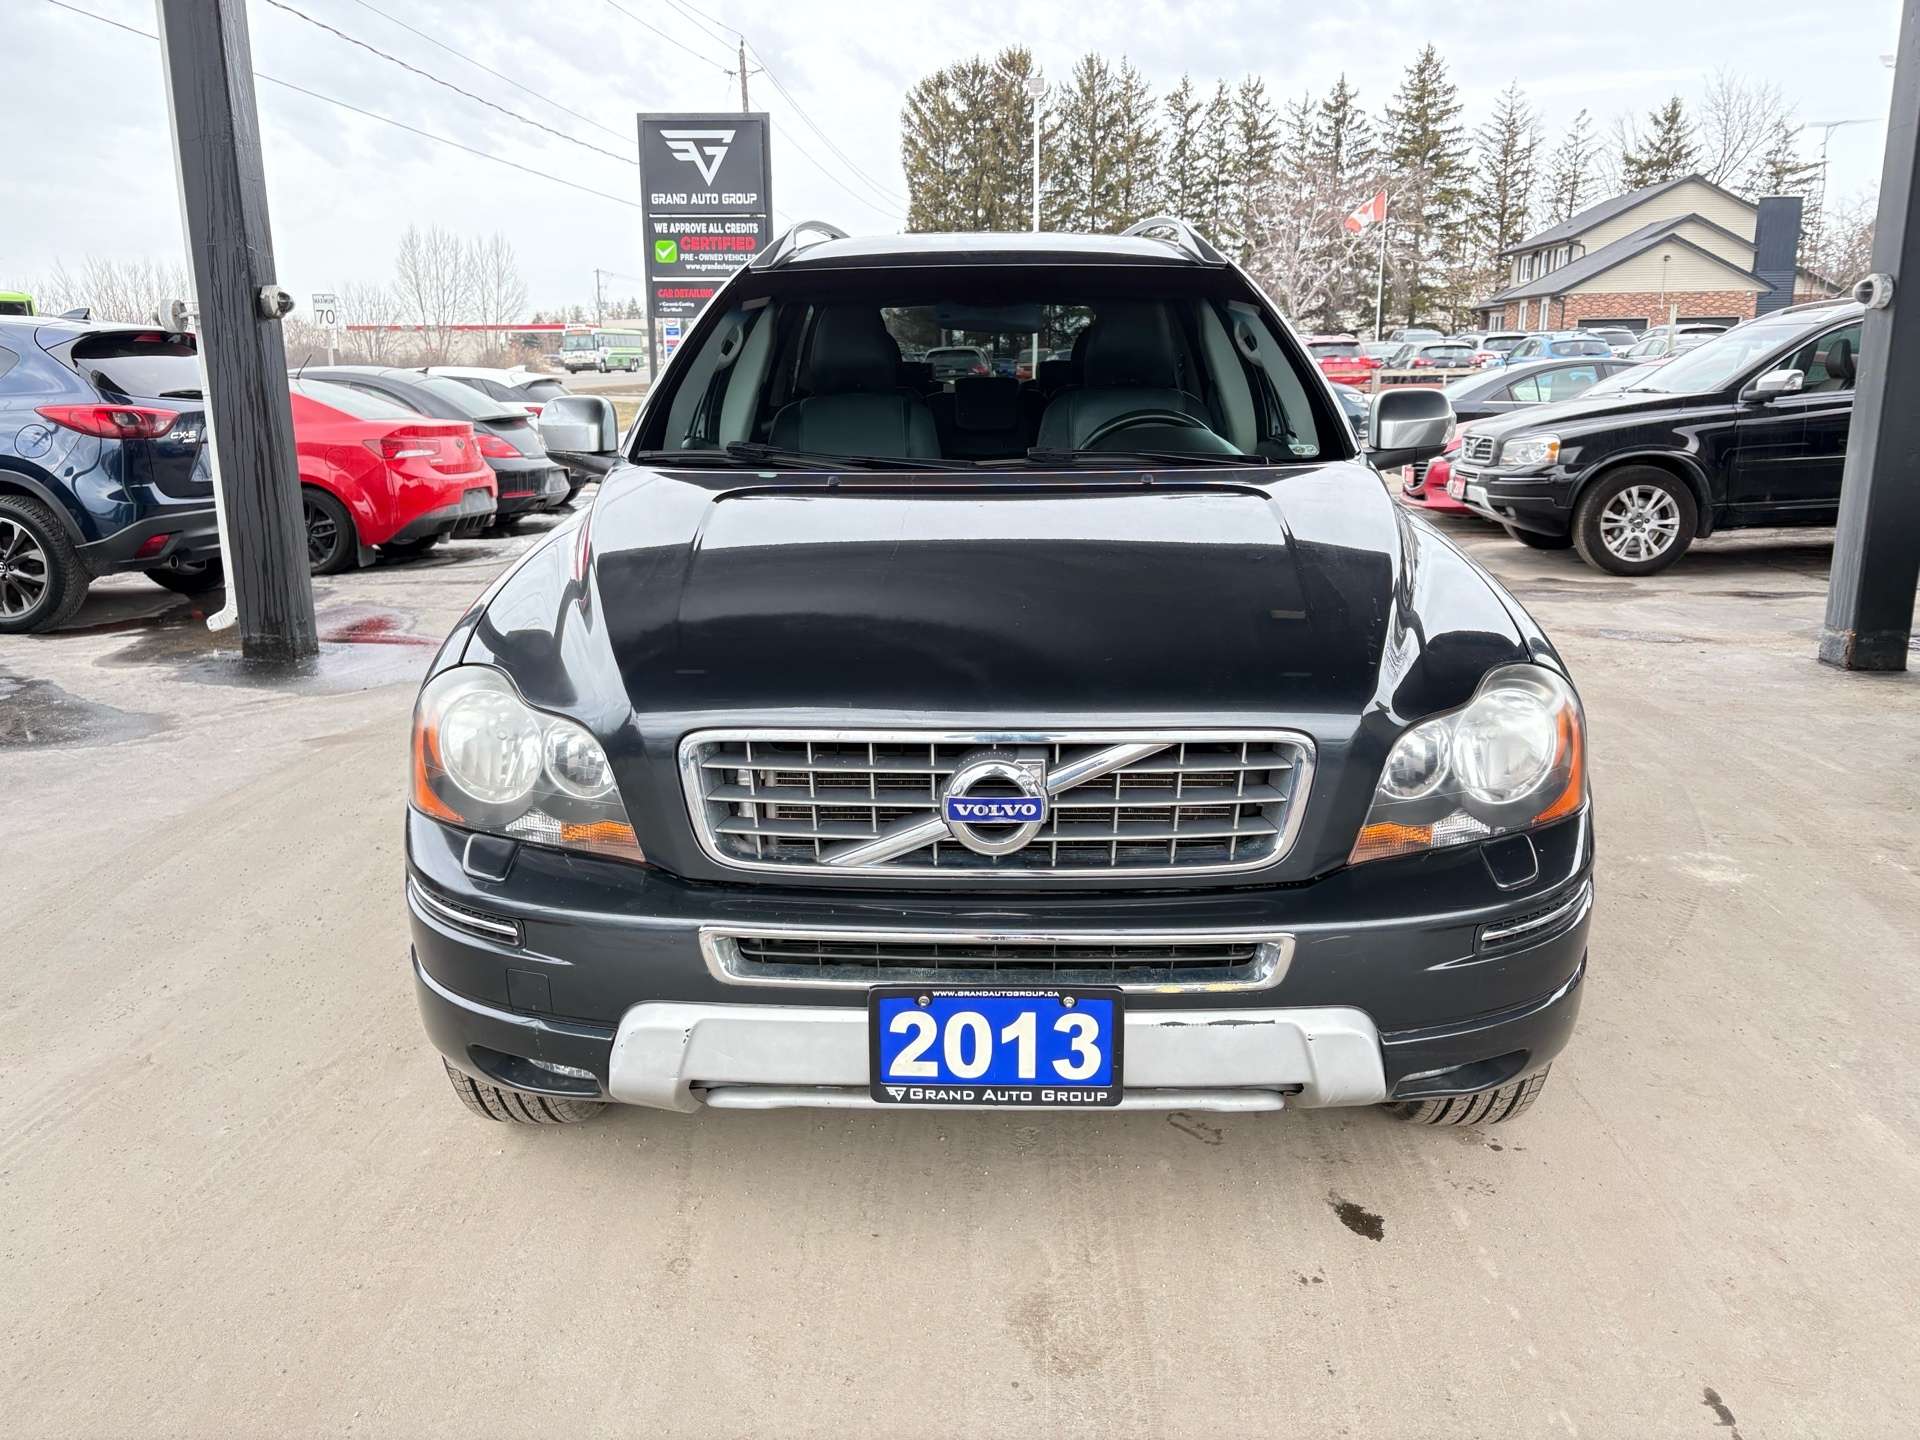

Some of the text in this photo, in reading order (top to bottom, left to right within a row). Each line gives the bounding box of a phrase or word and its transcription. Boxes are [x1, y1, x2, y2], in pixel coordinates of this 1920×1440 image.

[651, 193, 758, 204] GRAND AUTO GROUP
[654, 222, 759, 234] WE APPROVE ALL CREDITS
[680, 235, 756, 251] CERTIFIED
[680, 253, 694, 261] PRE
[699, 253, 723, 261] OWNED
[657, 288, 714, 299] CAR DETAILING
[316, 309, 335, 324] 70
[170, 430, 197, 440] CX-5
[953, 804, 1037, 816] VOLVO
[888, 1010, 1102, 1081] 2013
